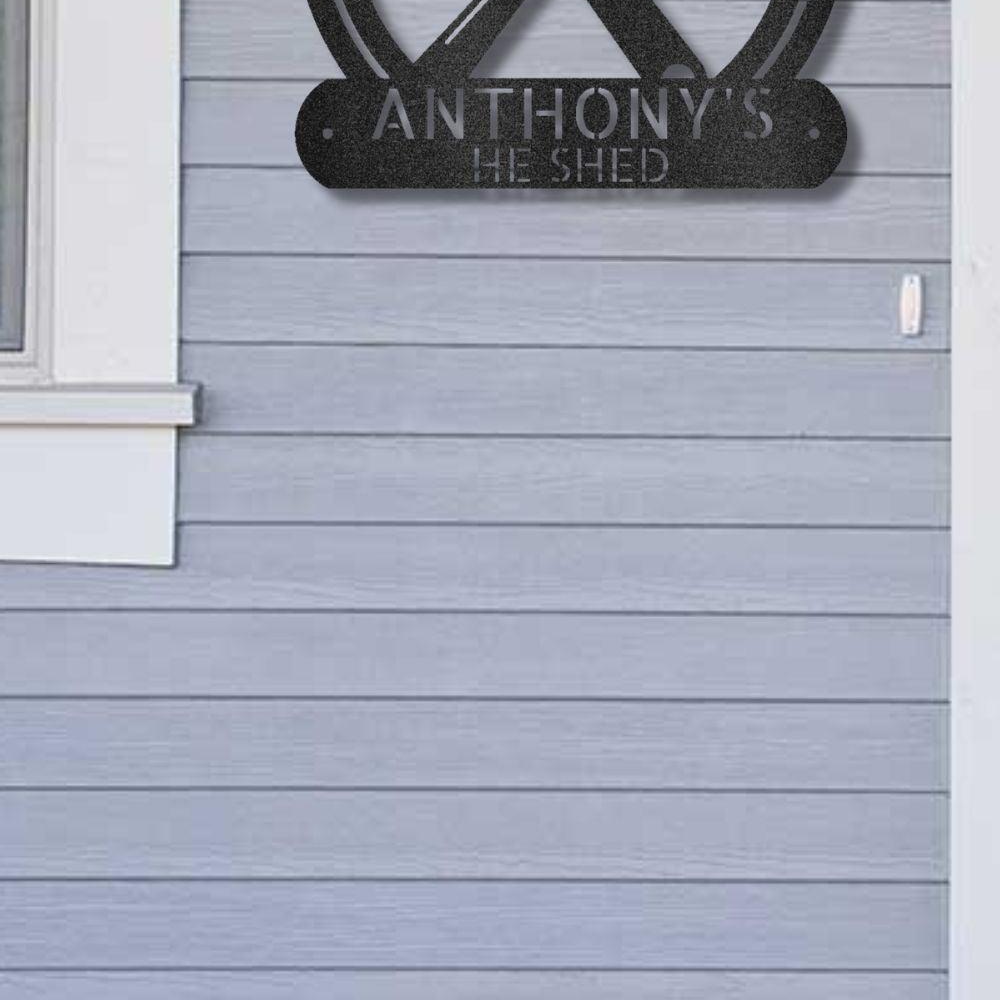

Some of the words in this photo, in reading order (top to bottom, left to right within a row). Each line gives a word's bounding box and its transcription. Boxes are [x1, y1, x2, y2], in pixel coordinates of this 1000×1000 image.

[372, 86, 773, 140] ANTHONY'S
[473, 147, 531, 183] HE
[551, 147, 670, 183] SHED
